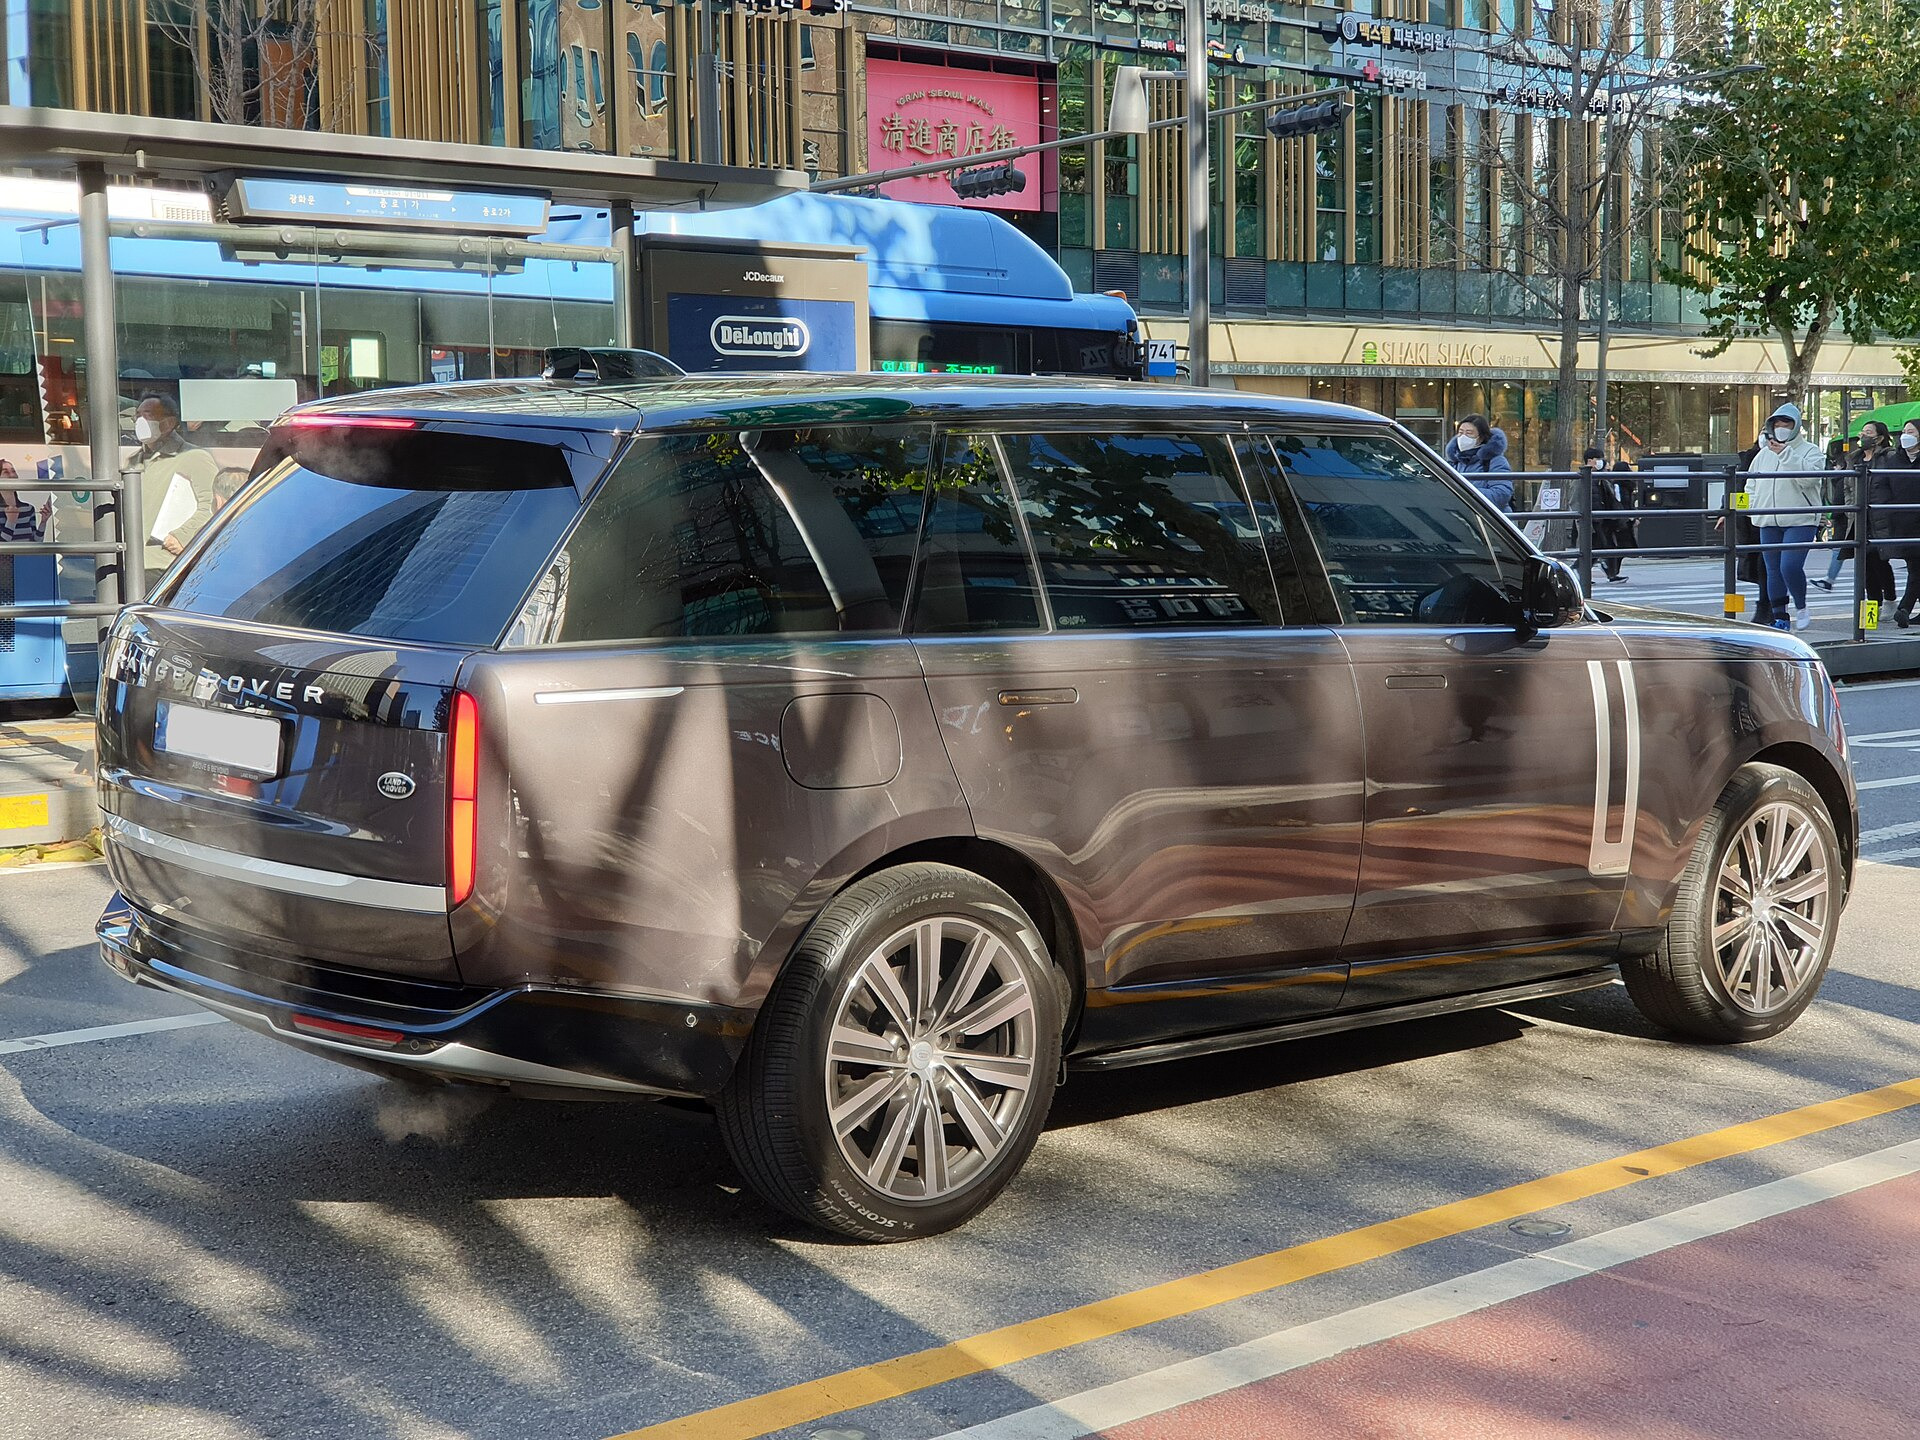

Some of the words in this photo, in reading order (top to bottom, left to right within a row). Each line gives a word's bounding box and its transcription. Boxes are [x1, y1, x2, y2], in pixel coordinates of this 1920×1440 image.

[1359, 22, 1391, 44] 맥스웰
[1394, 28, 1444, 51] 피부과의원
[1381, 66, 1427, 91] 헌혈의집
[896, 90, 925, 106] GRAN
[929, 89, 963, 100] SEOUL
[967, 94, 995, 116] MALL
[289, 194, 316, 206] 광화문
[482, 206, 511, 217] 종로2가
[743, 271, 785, 283] JCDecaux
[1150, 343, 1175, 359] 741
[1381, 341, 1431, 365] SHAKE
[1438, 343, 1494, 366] SHACK
[203, 671, 325, 705] ROVER
[384, 777, 402, 785] LAND
[385, 785, 407, 793] ROVER
[931, 891, 955, 901] R22
[830, 1179, 898, 1228] SCORPION
